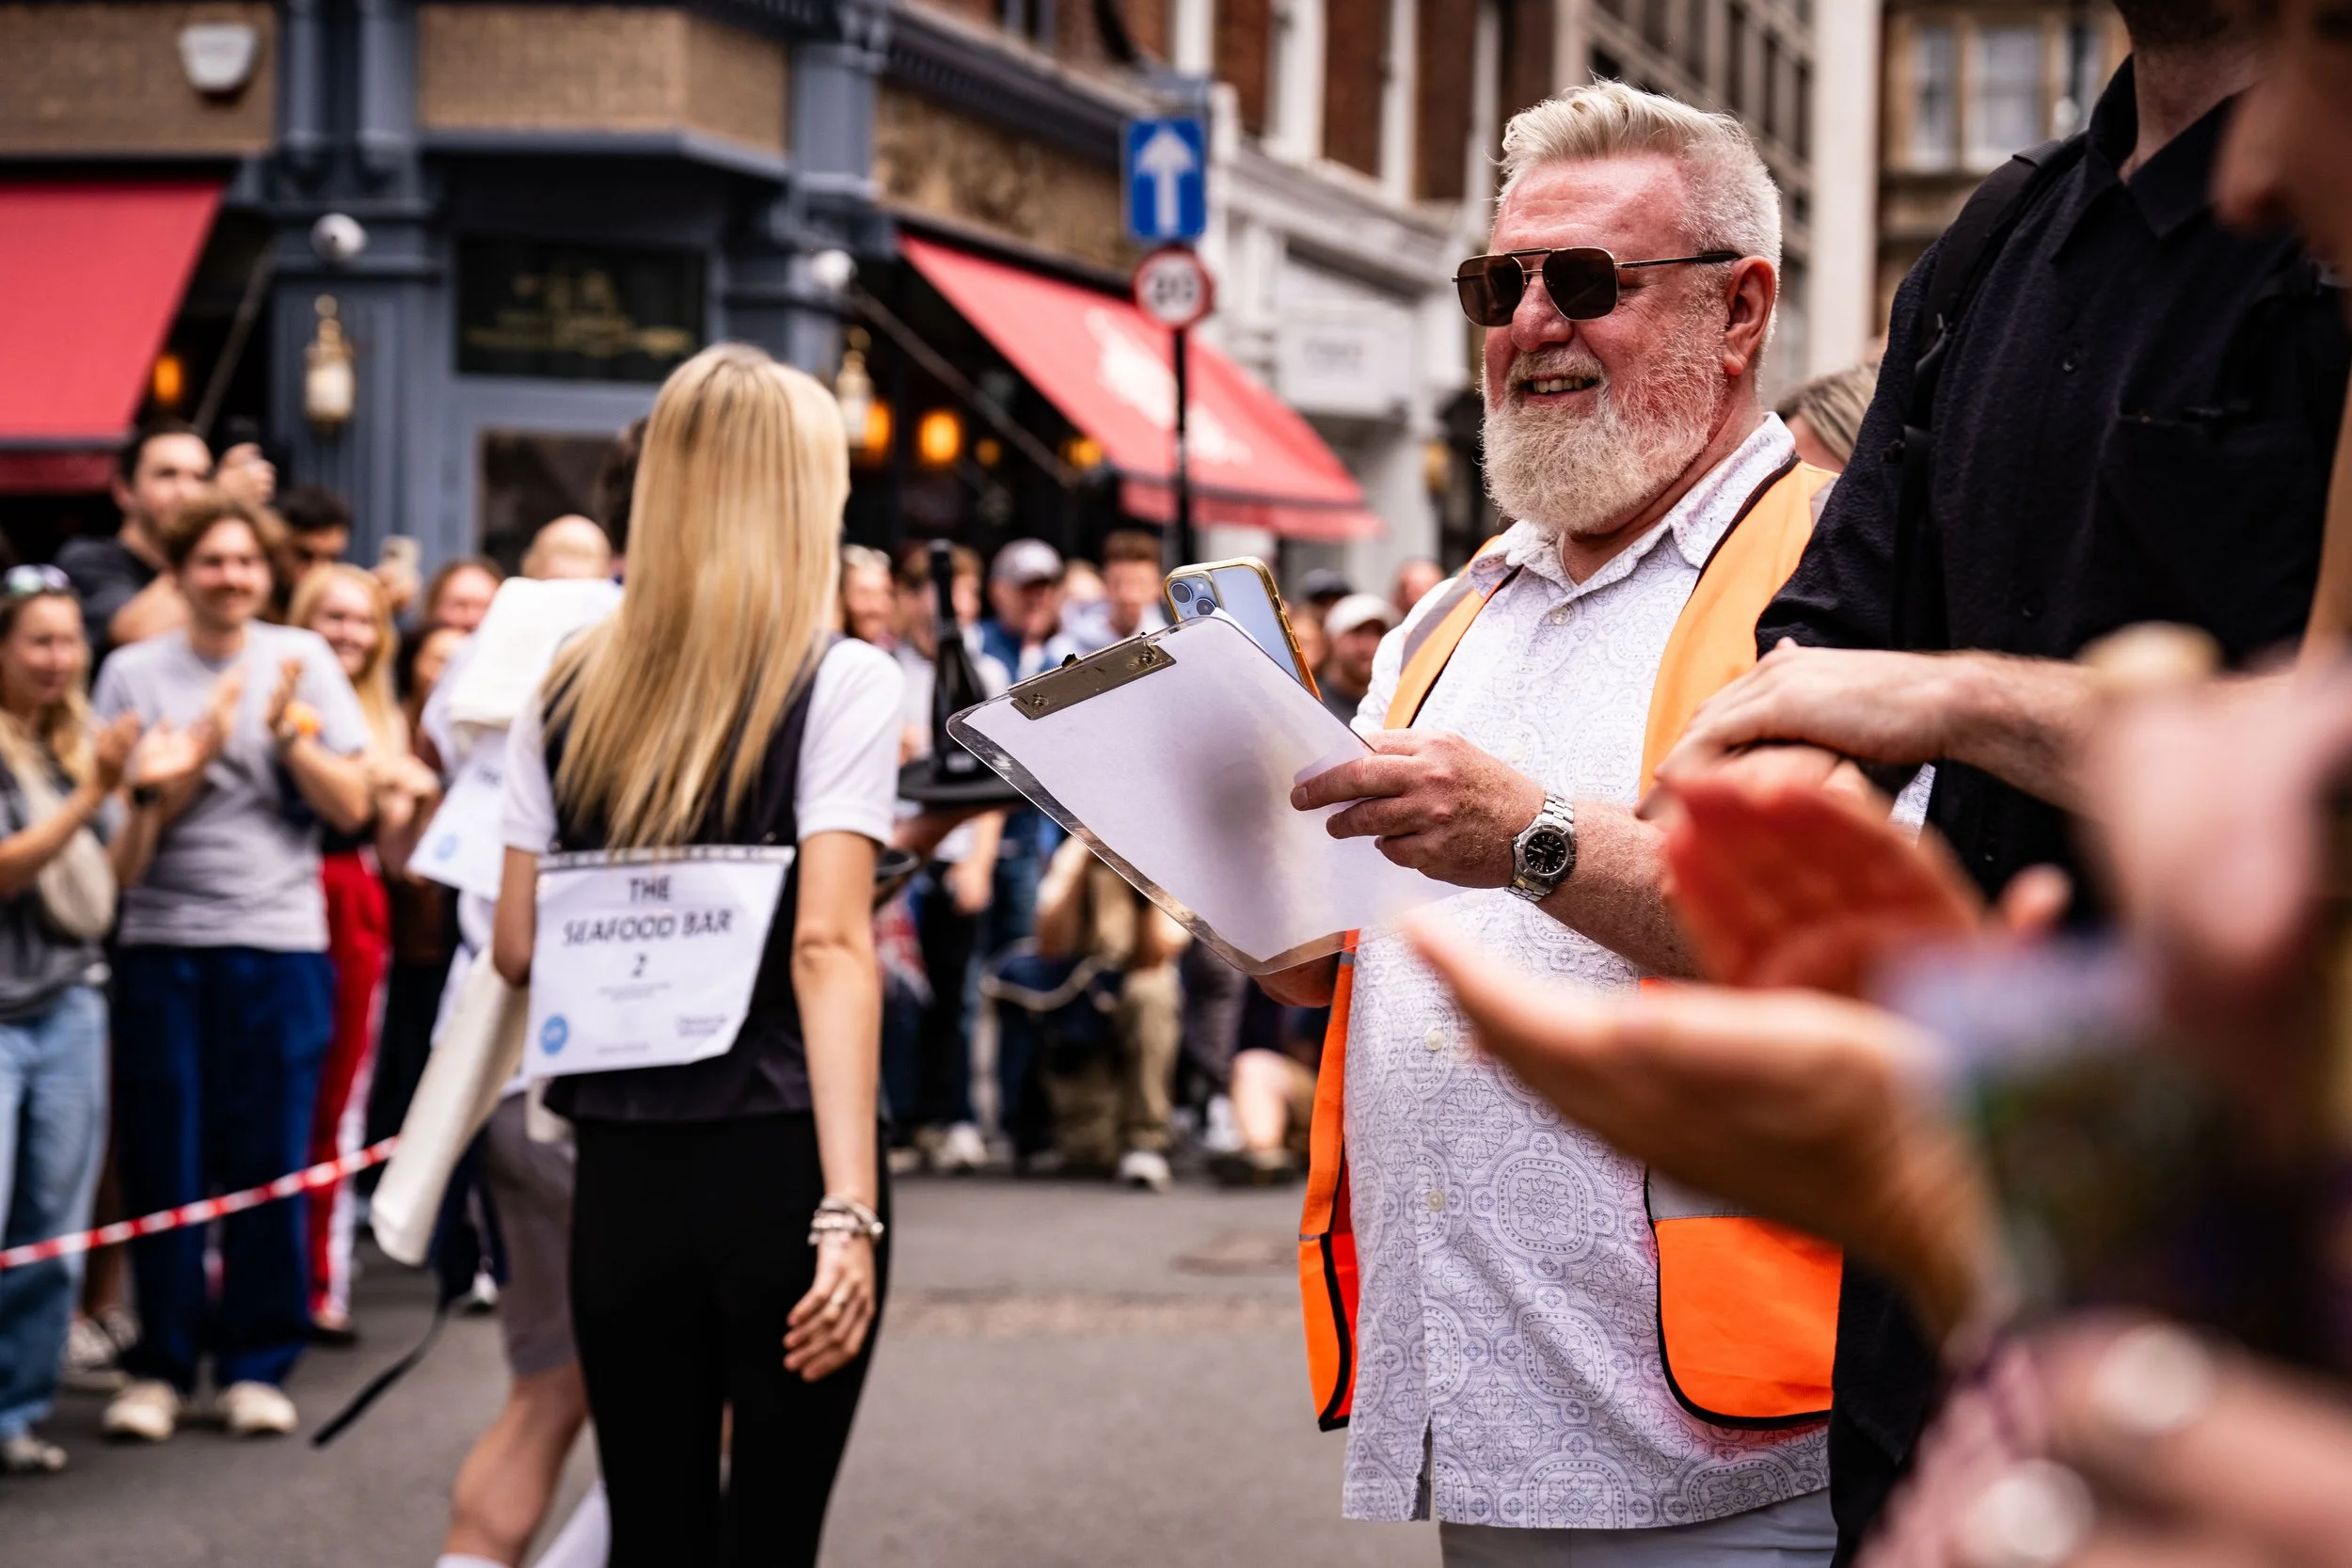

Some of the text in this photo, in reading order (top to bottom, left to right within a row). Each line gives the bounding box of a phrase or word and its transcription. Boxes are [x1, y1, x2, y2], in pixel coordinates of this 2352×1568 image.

[628, 876, 671, 903] THE
[564, 910, 732, 945] SEAFOOD BAR
[631, 953, 647, 978] 2
